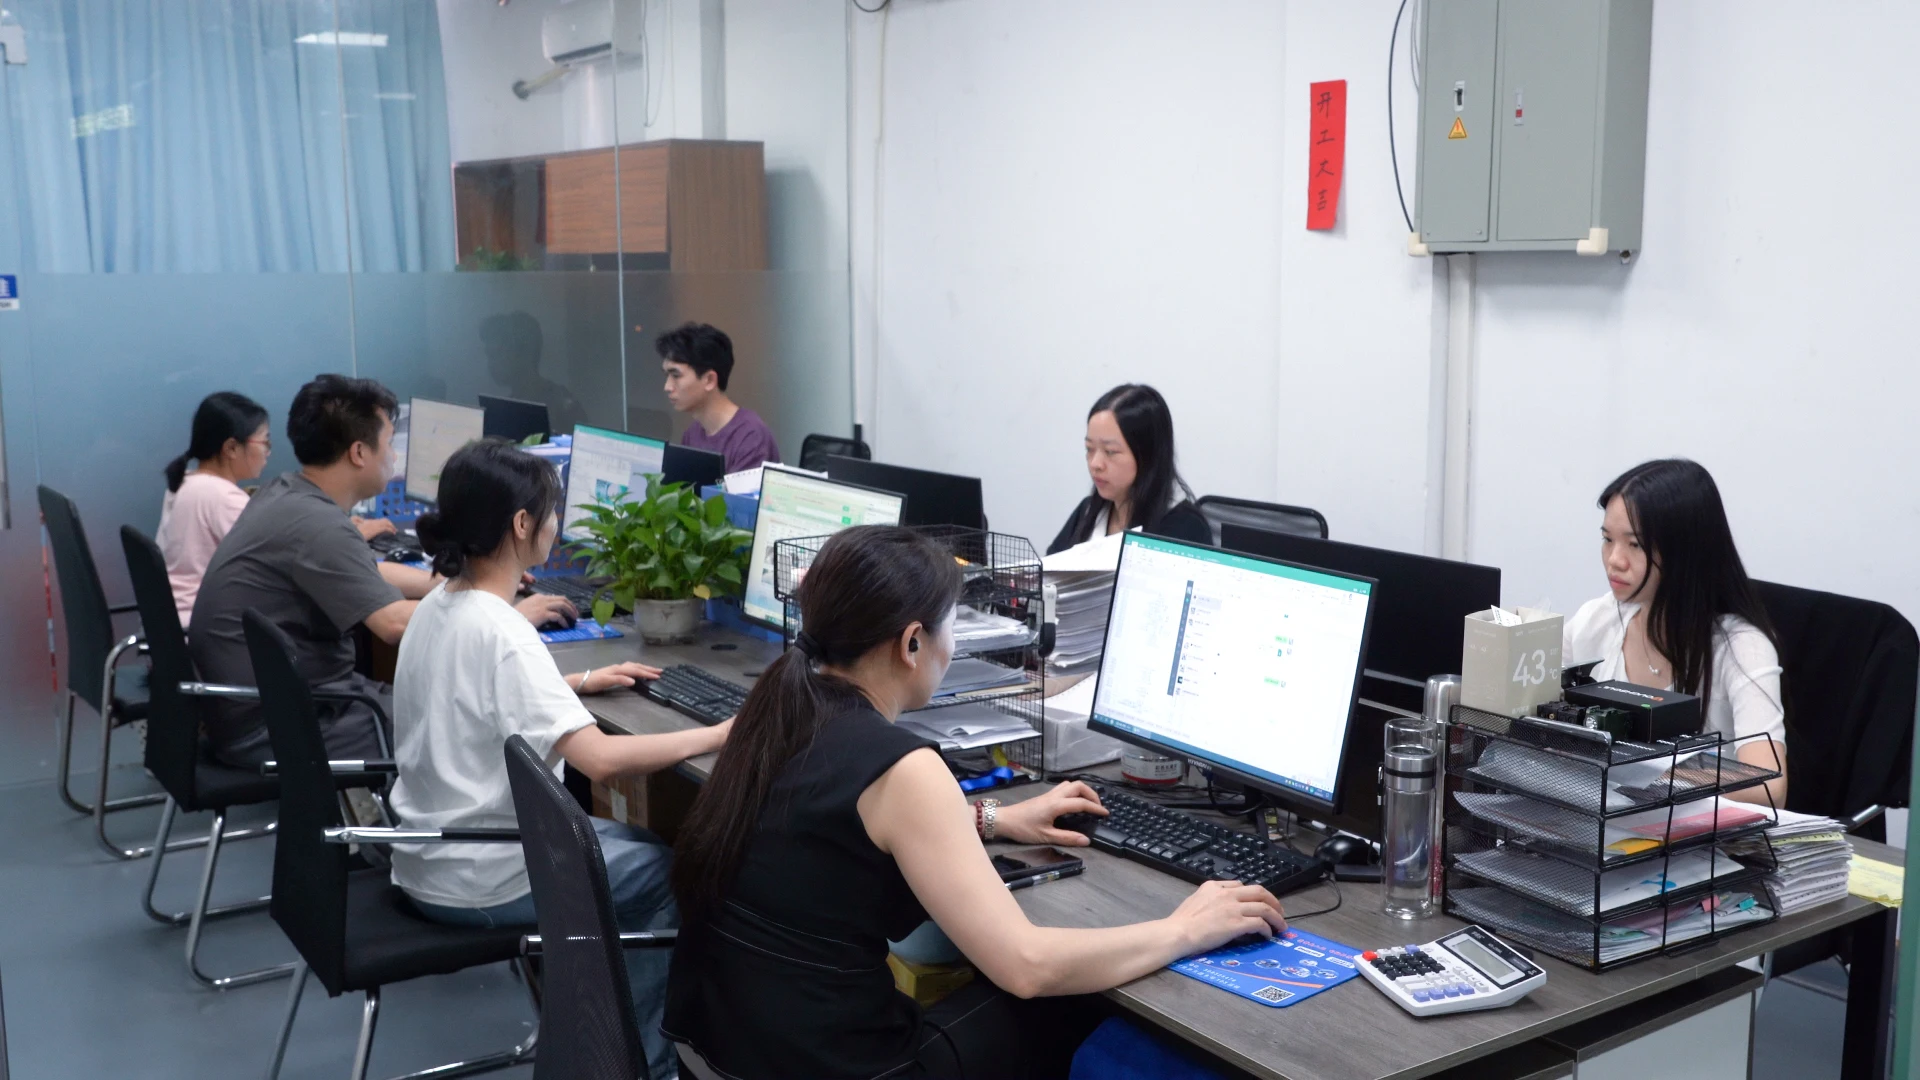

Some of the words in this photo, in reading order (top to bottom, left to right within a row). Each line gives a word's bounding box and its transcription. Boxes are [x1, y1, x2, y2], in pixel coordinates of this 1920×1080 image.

[1316, 91, 1336, 211] 开工大吉
[1512, 649, 1546, 687] 43
